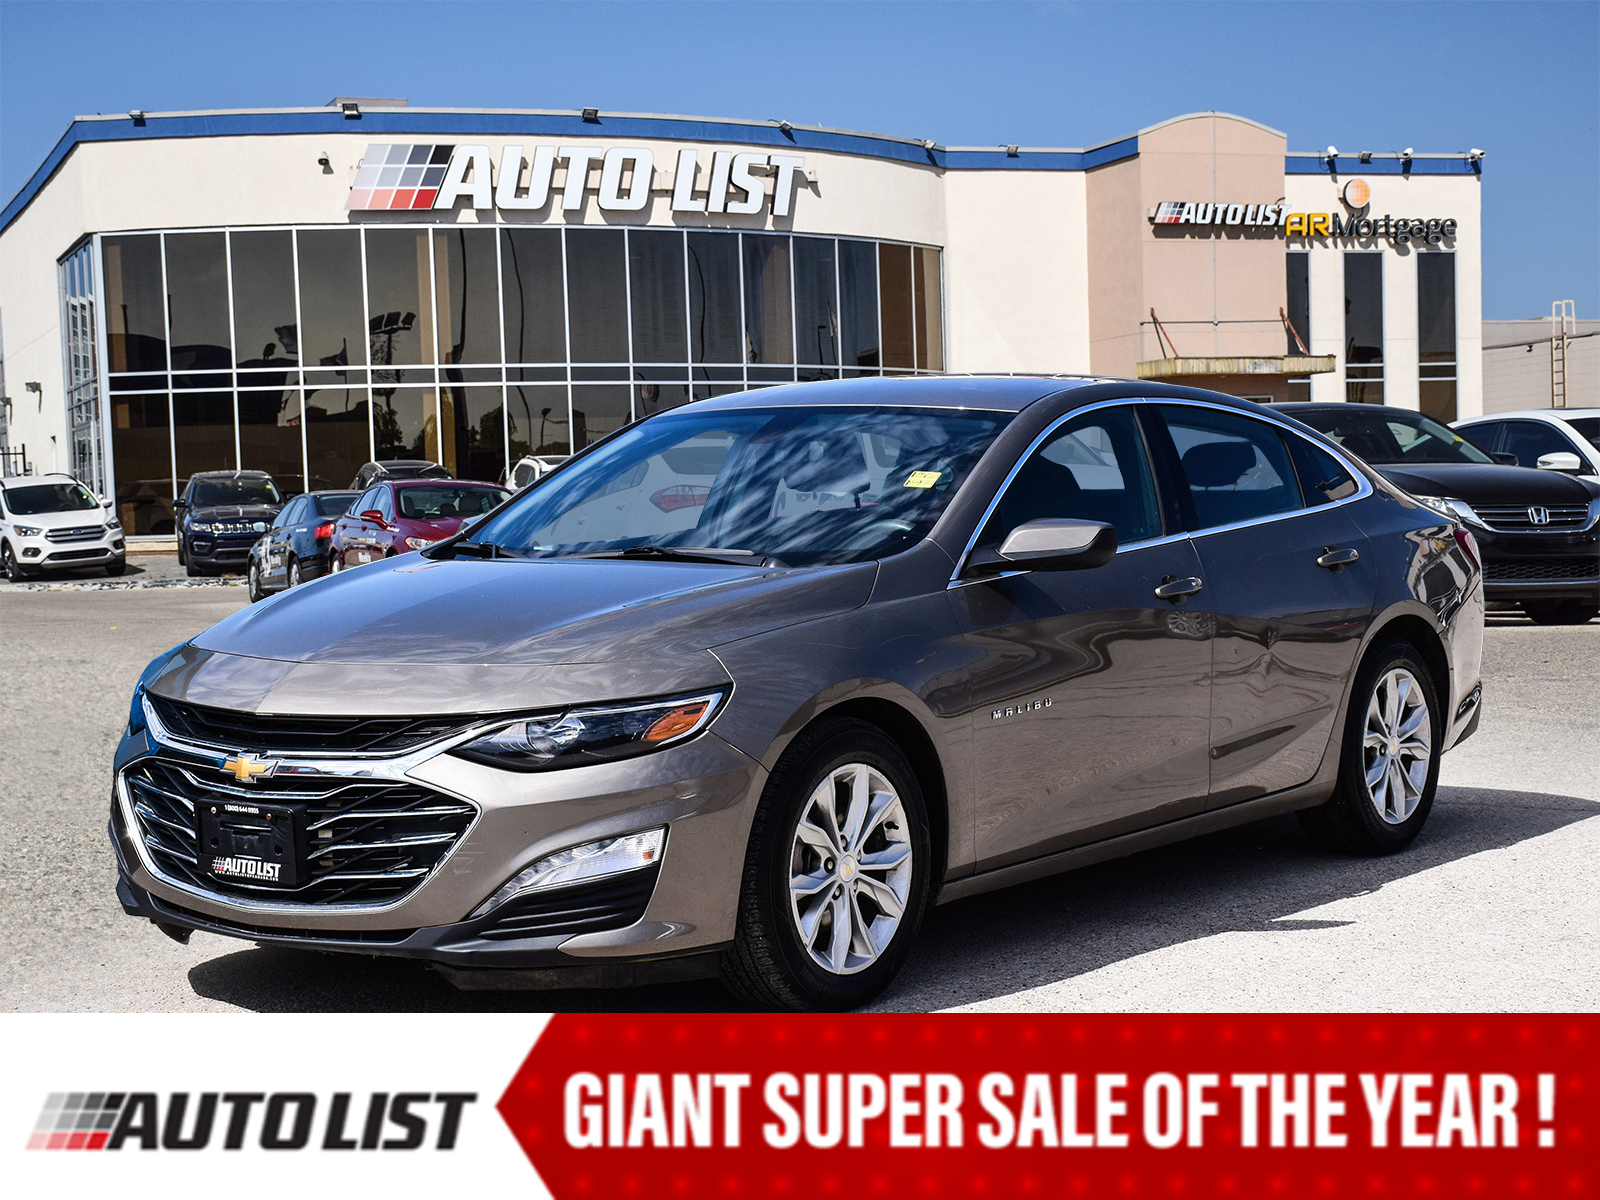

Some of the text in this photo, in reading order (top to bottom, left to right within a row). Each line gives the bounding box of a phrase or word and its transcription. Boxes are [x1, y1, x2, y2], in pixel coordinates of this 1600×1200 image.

[434, 145, 805, 216] AUTO LIST
[1178, 203, 1292, 226] AUTO LIST
[1285, 212, 1458, 245] AR Mortgage
[991, 698, 1052, 720] MALIBU
[223, 857, 281, 878] AUTO LIST
